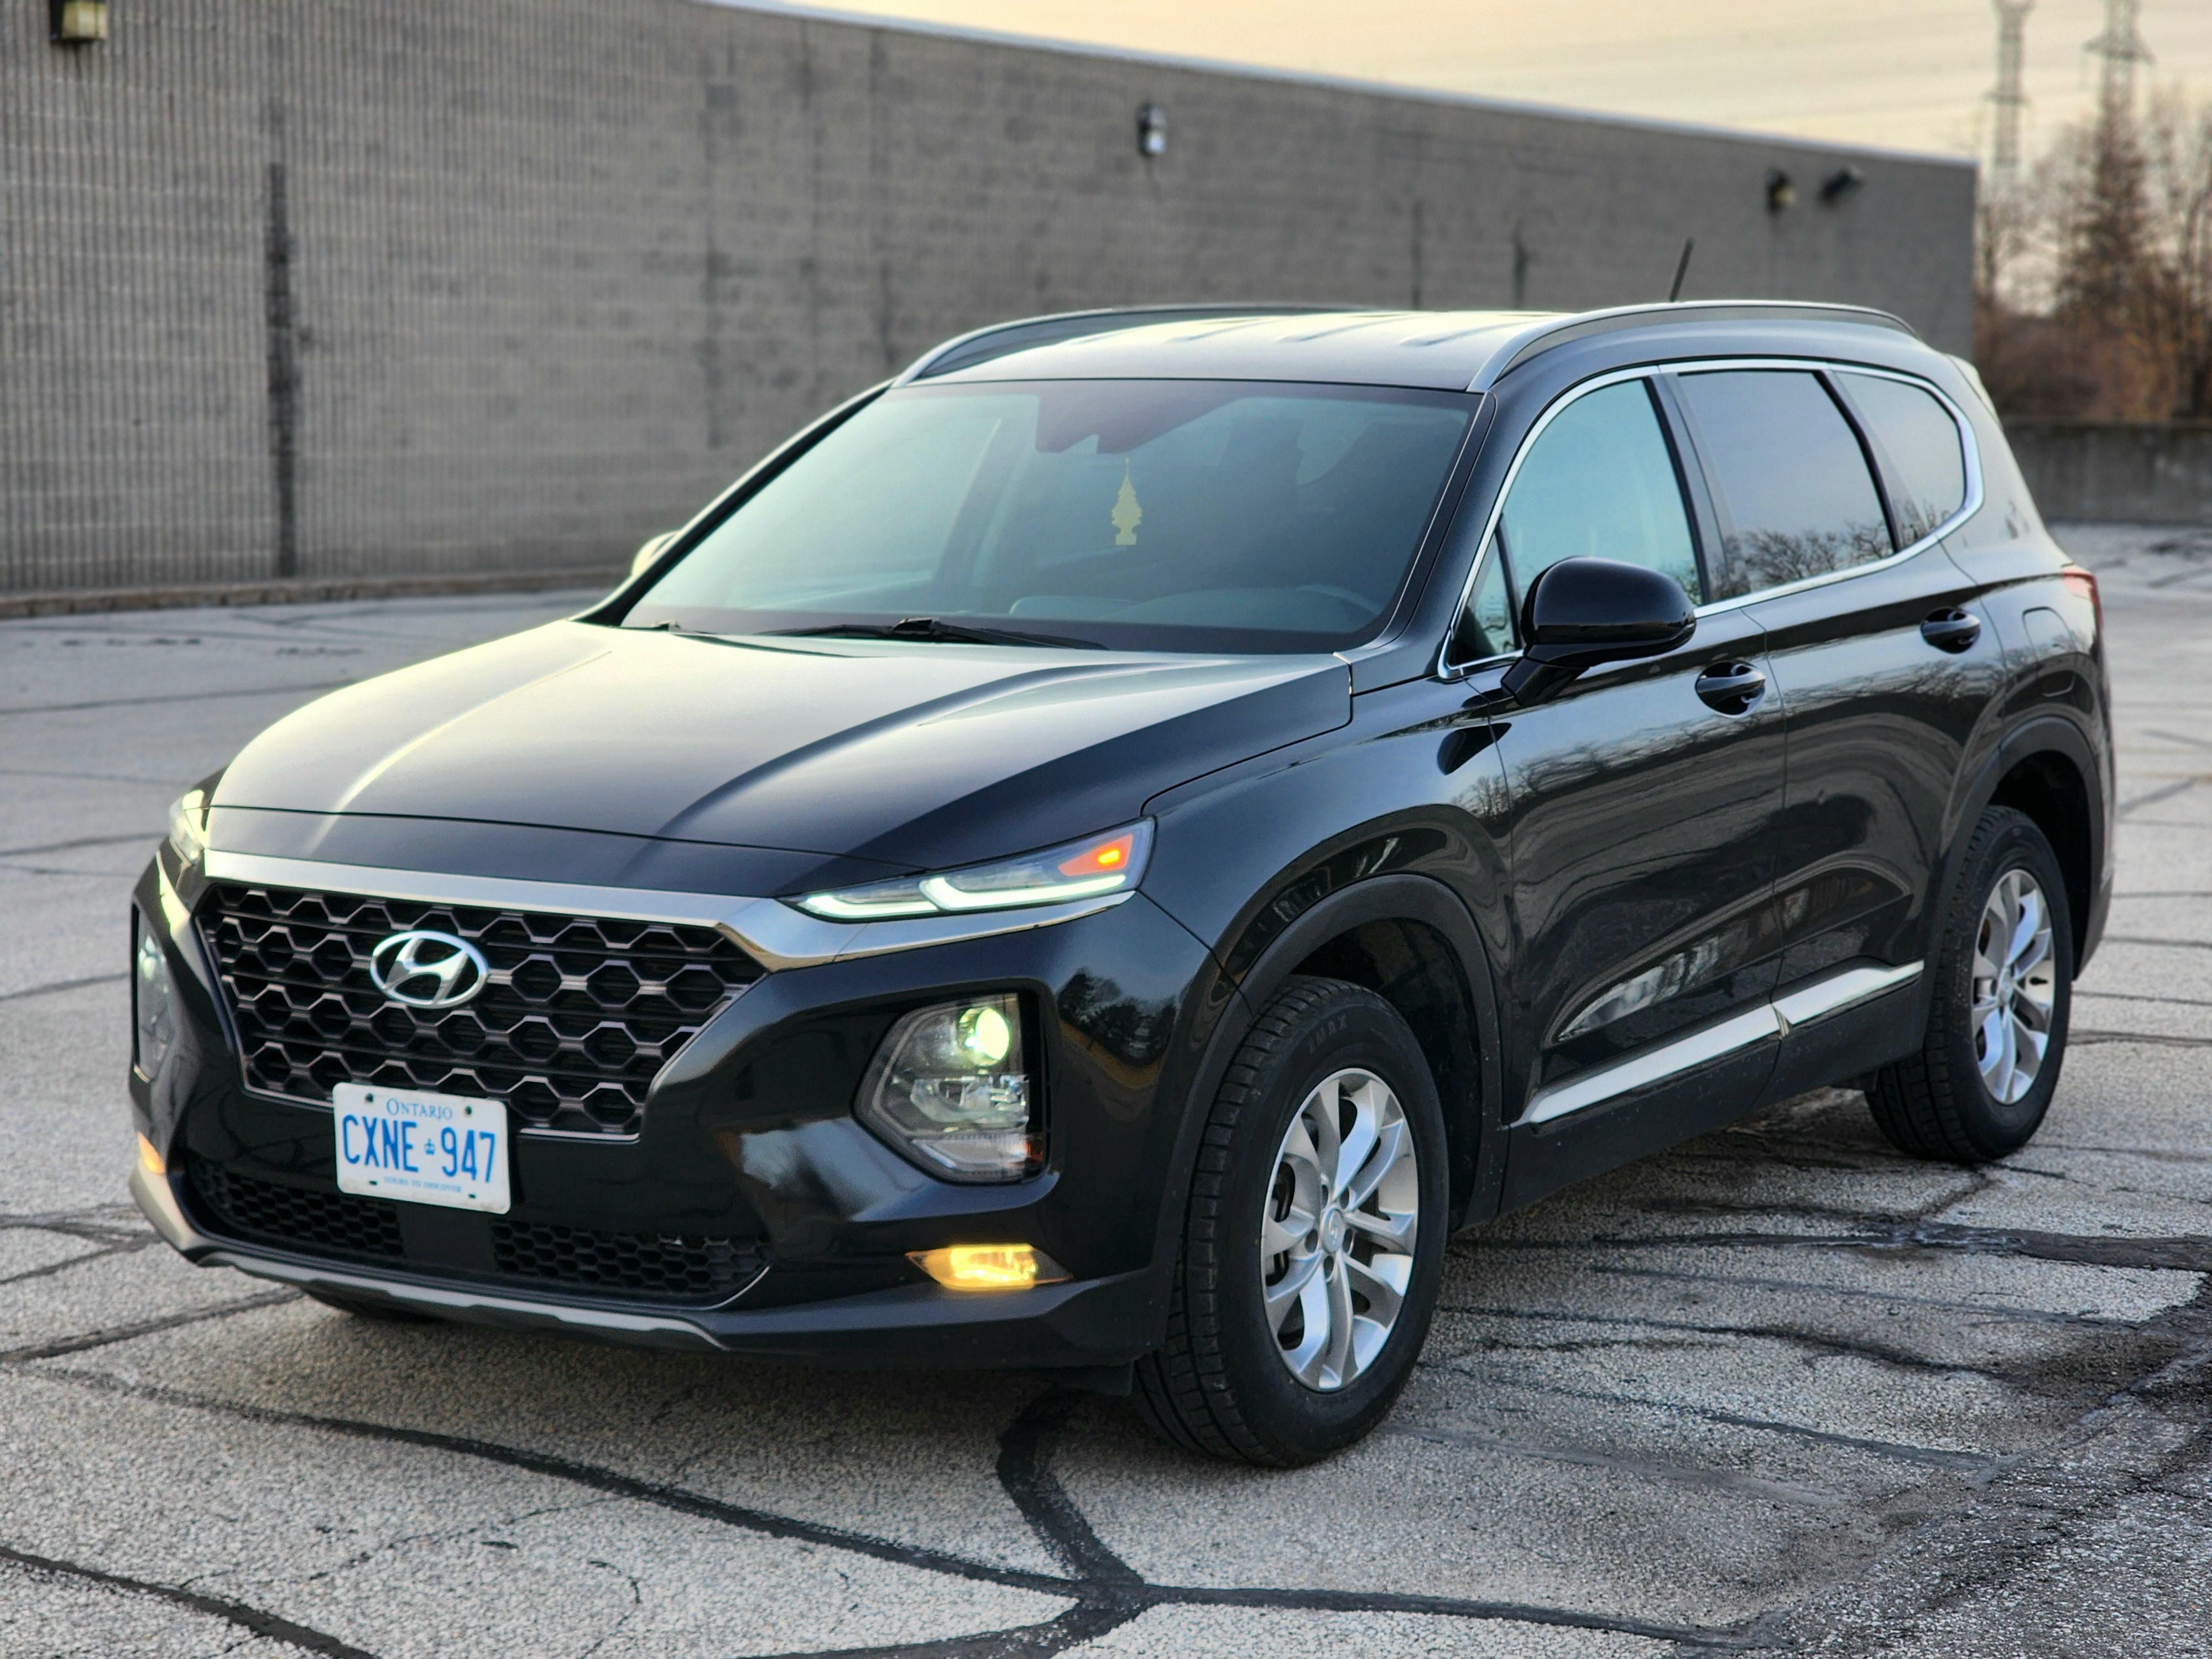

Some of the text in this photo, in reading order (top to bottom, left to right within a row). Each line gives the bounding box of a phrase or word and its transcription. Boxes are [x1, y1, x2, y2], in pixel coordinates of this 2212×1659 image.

[386, 1098, 453, 1120] ONTARIO
[342, 1114, 495, 1183] CXNE 947
